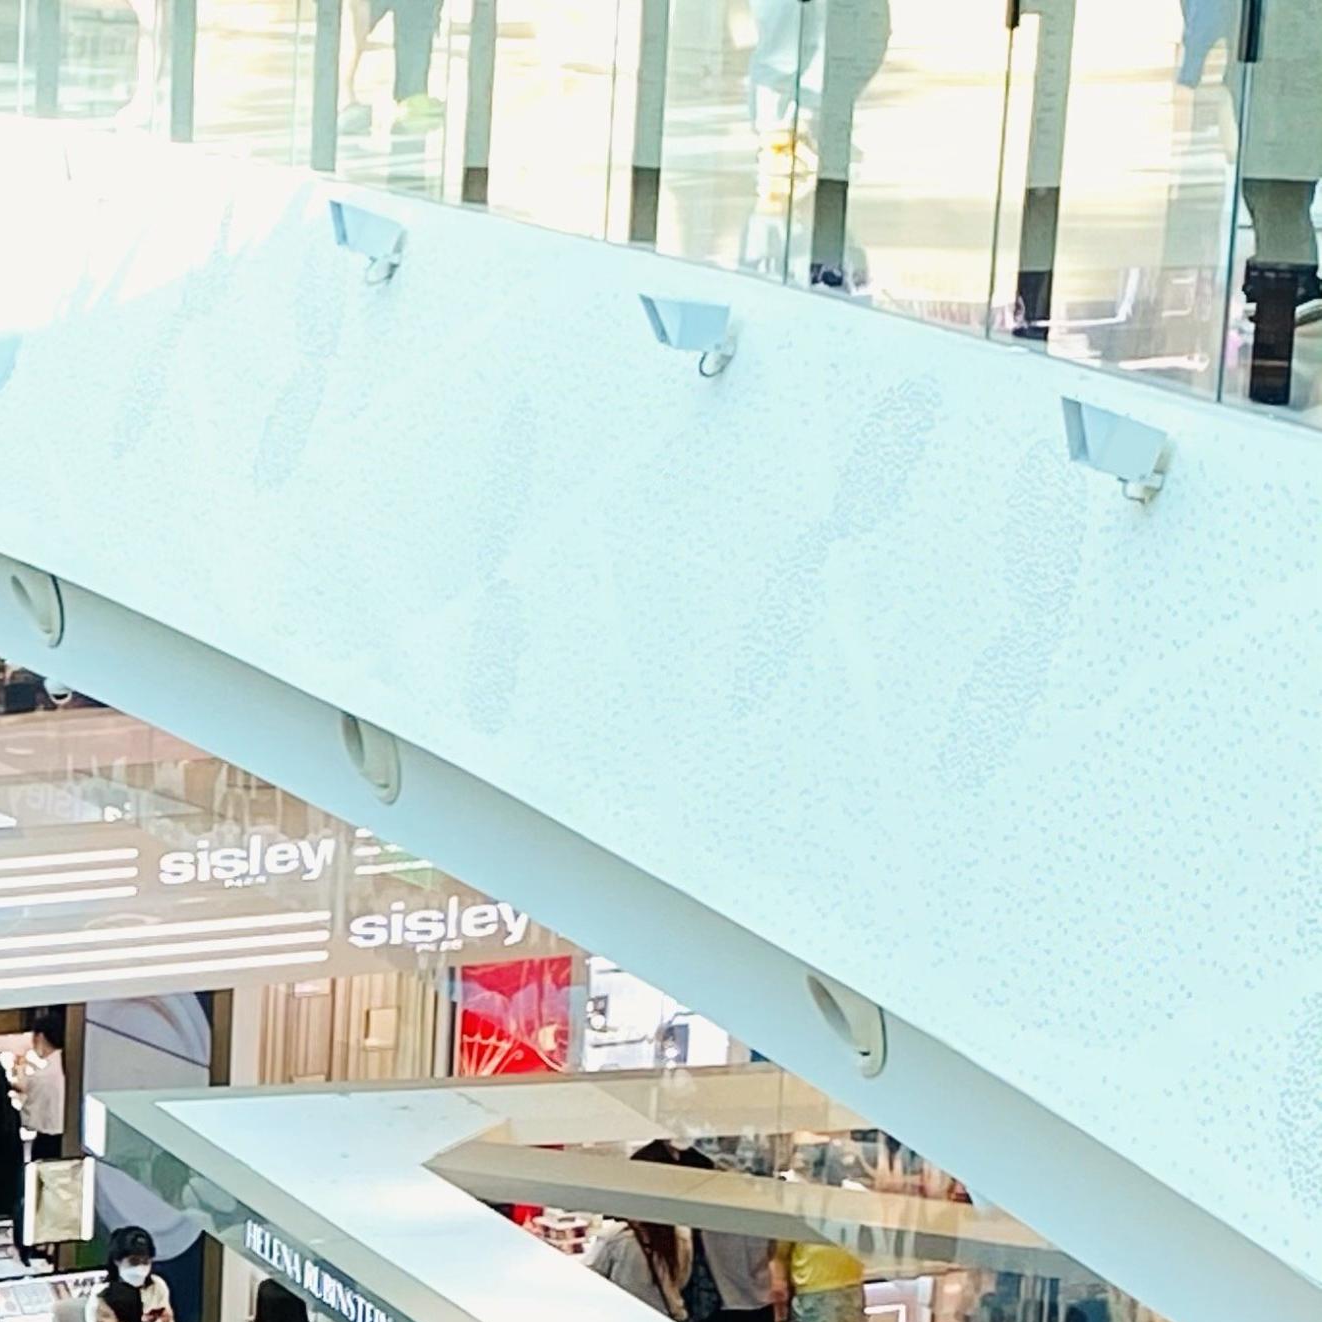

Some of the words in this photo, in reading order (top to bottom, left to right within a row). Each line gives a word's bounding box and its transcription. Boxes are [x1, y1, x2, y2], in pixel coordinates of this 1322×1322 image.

[159, 834, 336, 886] sisley
[348, 895, 531, 949] sisley
[245, 1219, 302, 1285] HELENA
